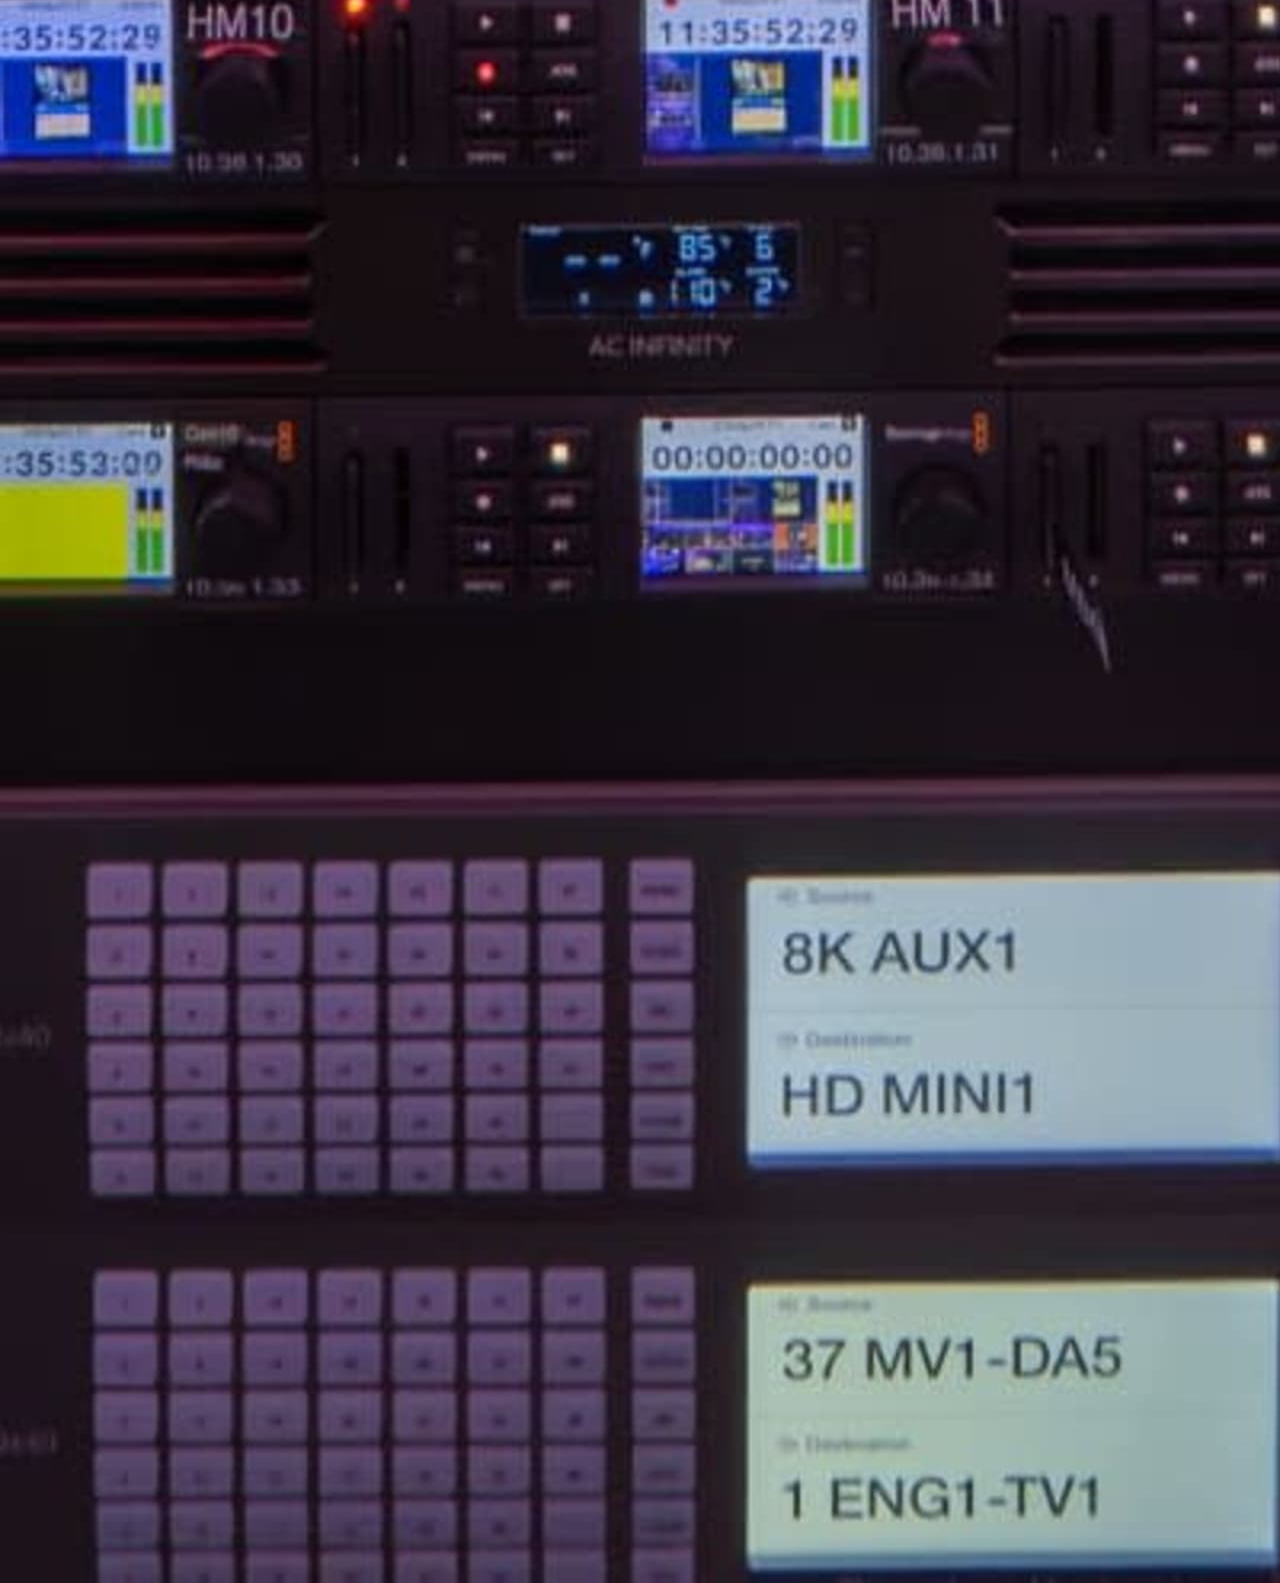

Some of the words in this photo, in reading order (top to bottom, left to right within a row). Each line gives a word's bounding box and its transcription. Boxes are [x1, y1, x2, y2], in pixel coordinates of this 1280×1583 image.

[187, 4, 294, 40] HM10
[679, 235, 718, 263] 85
[755, 235, 774, 262] 6
[588, 334, 625, 359] AC
[630, 333, 735, 357] INFINITY
[651, 442, 855, 471] 00:00:00:00
[781, 930, 856, 975] 8K
[871, 928, 1017, 974] AUX1
[781, 1073, 866, 1117] HD
[882, 1070, 1034, 1116] MINI1
[782, 1337, 848, 1382] 37
[865, 1334, 1124, 1380] MV1-DA5
[783, 1477, 803, 1521] 1
[830, 1473, 1100, 1521] ENG1-TV1
